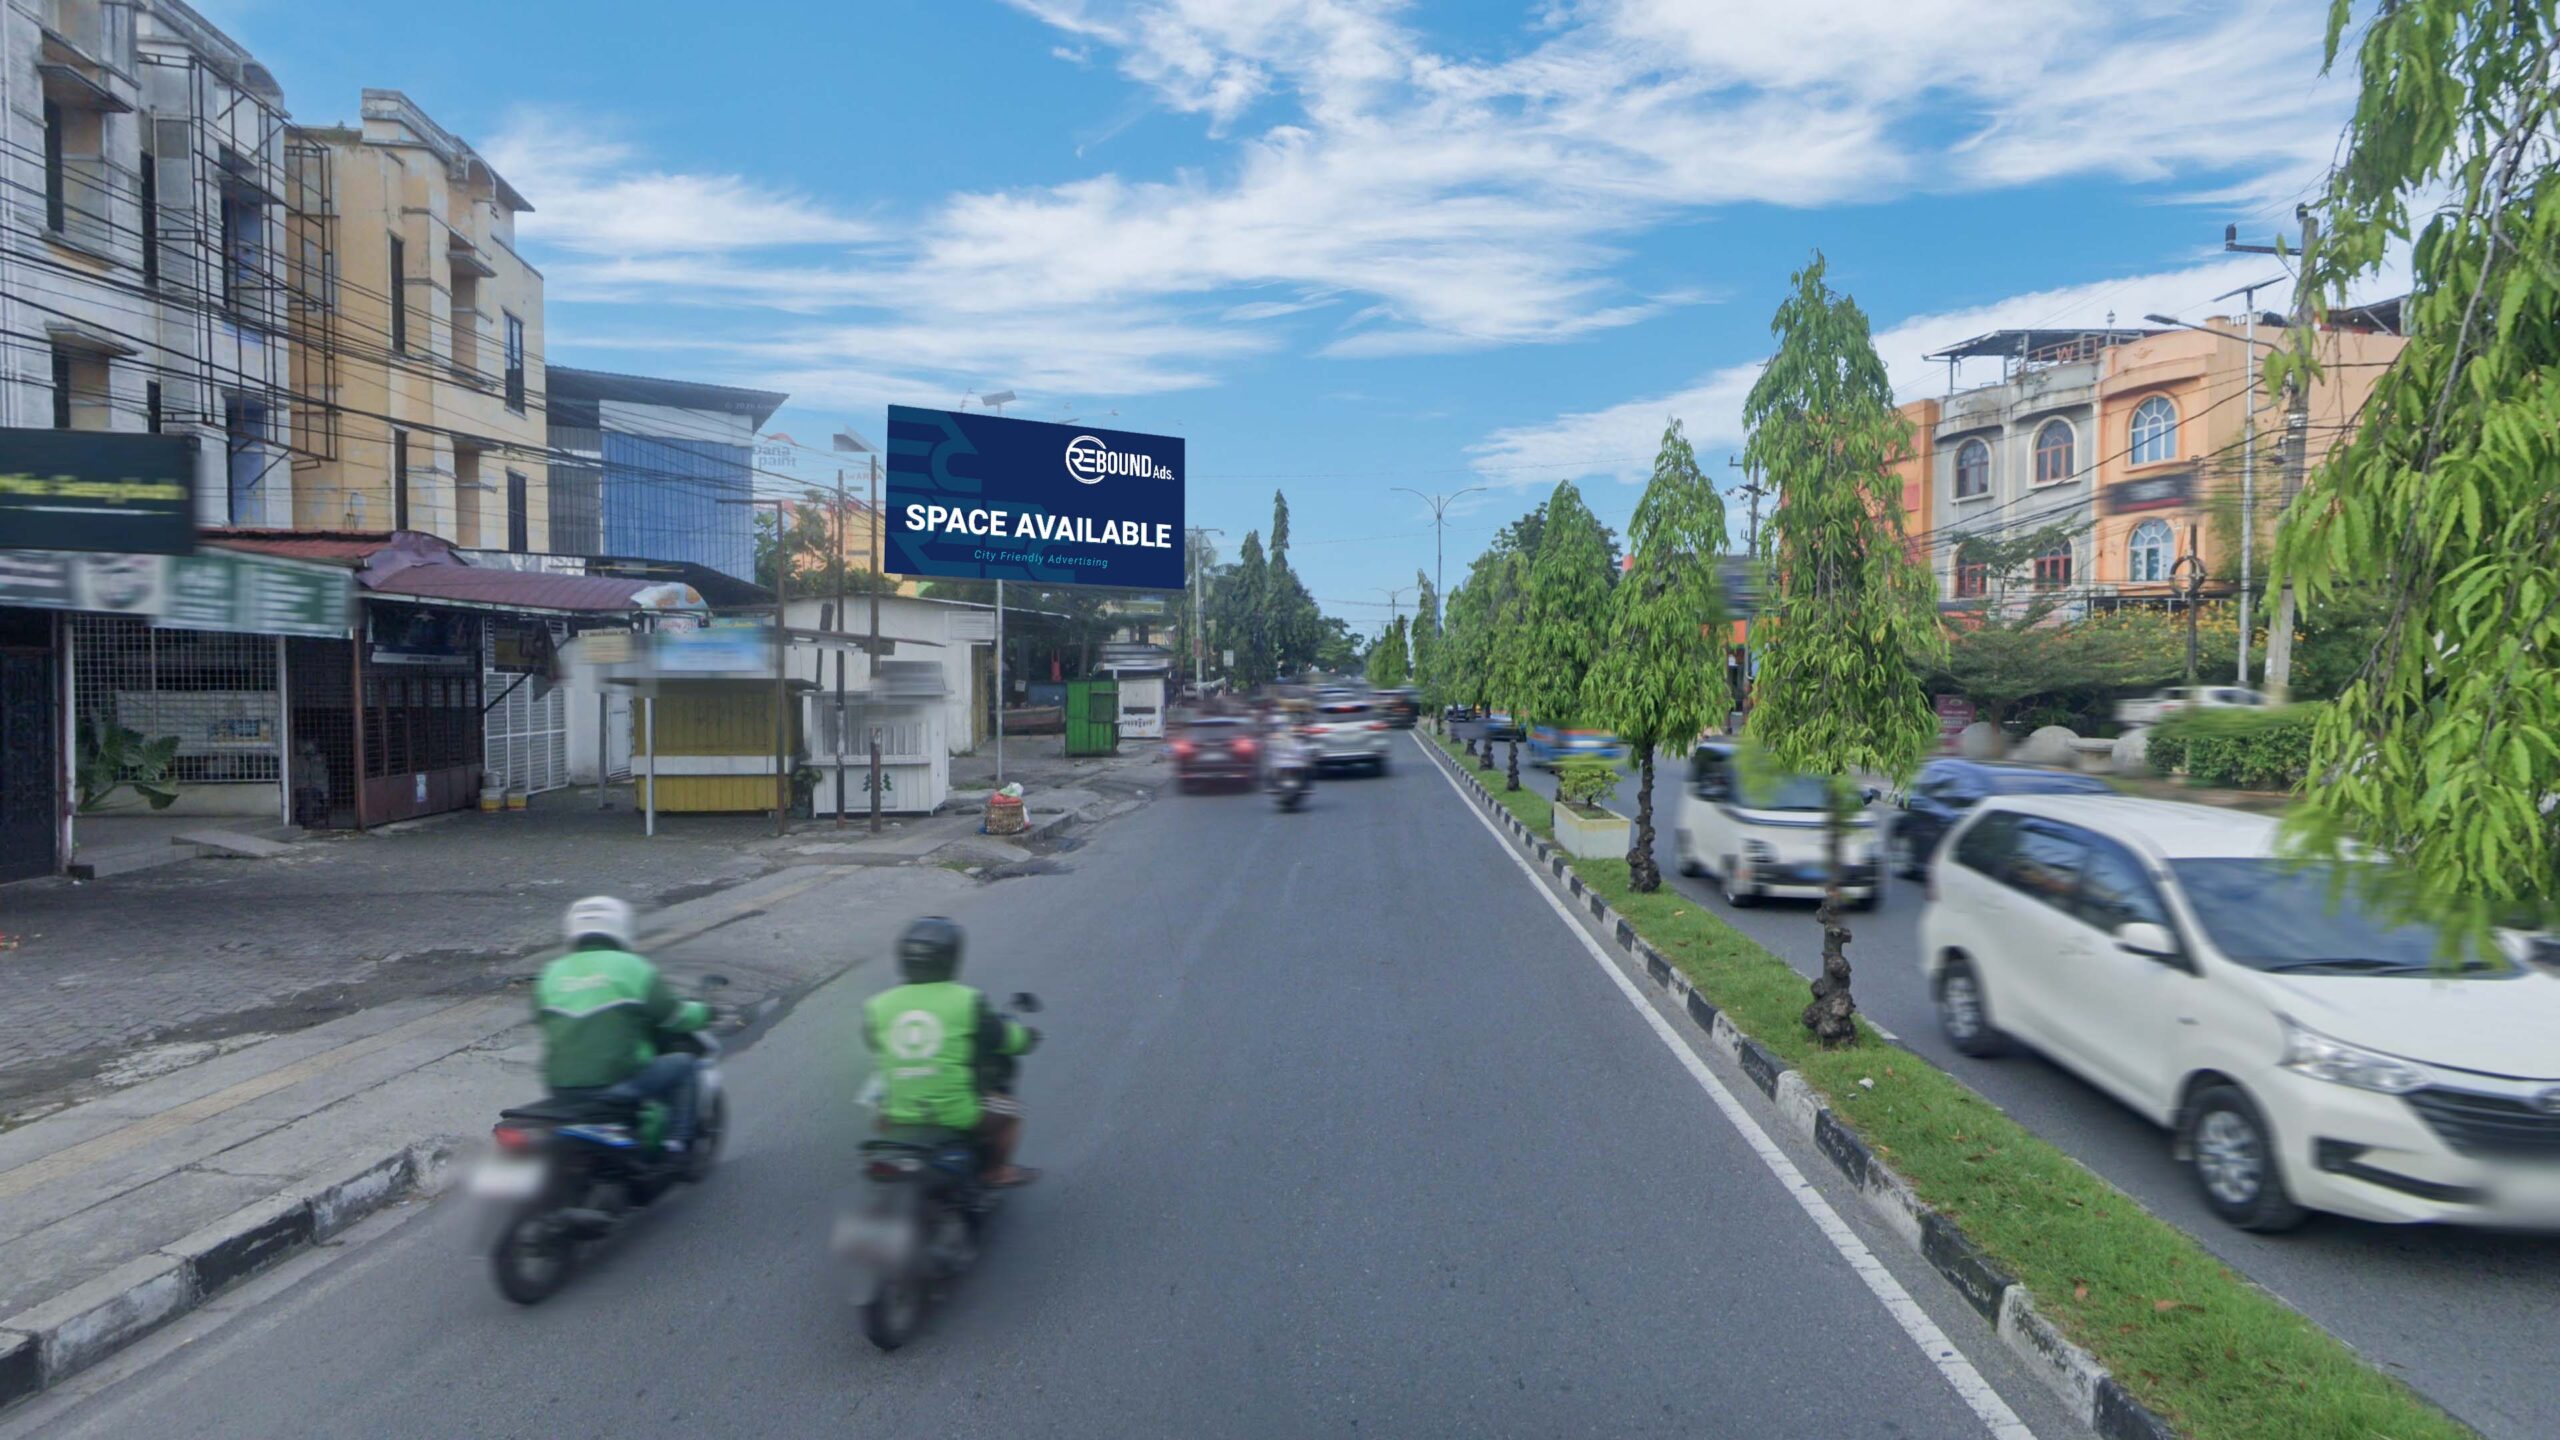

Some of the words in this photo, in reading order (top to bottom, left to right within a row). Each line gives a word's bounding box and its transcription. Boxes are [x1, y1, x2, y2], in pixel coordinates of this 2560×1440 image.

[1067, 445, 1152, 478] REBOUND
[1153, 465, 1175, 480] Ads.
[905, 503, 1008, 537] SPACE
[1014, 512, 1172, 549] AVAILABLE
[974, 550, 996, 561] City
[1000, 551, 1043, 565] Friendly
[1047, 554, 1108, 568] Advertising
